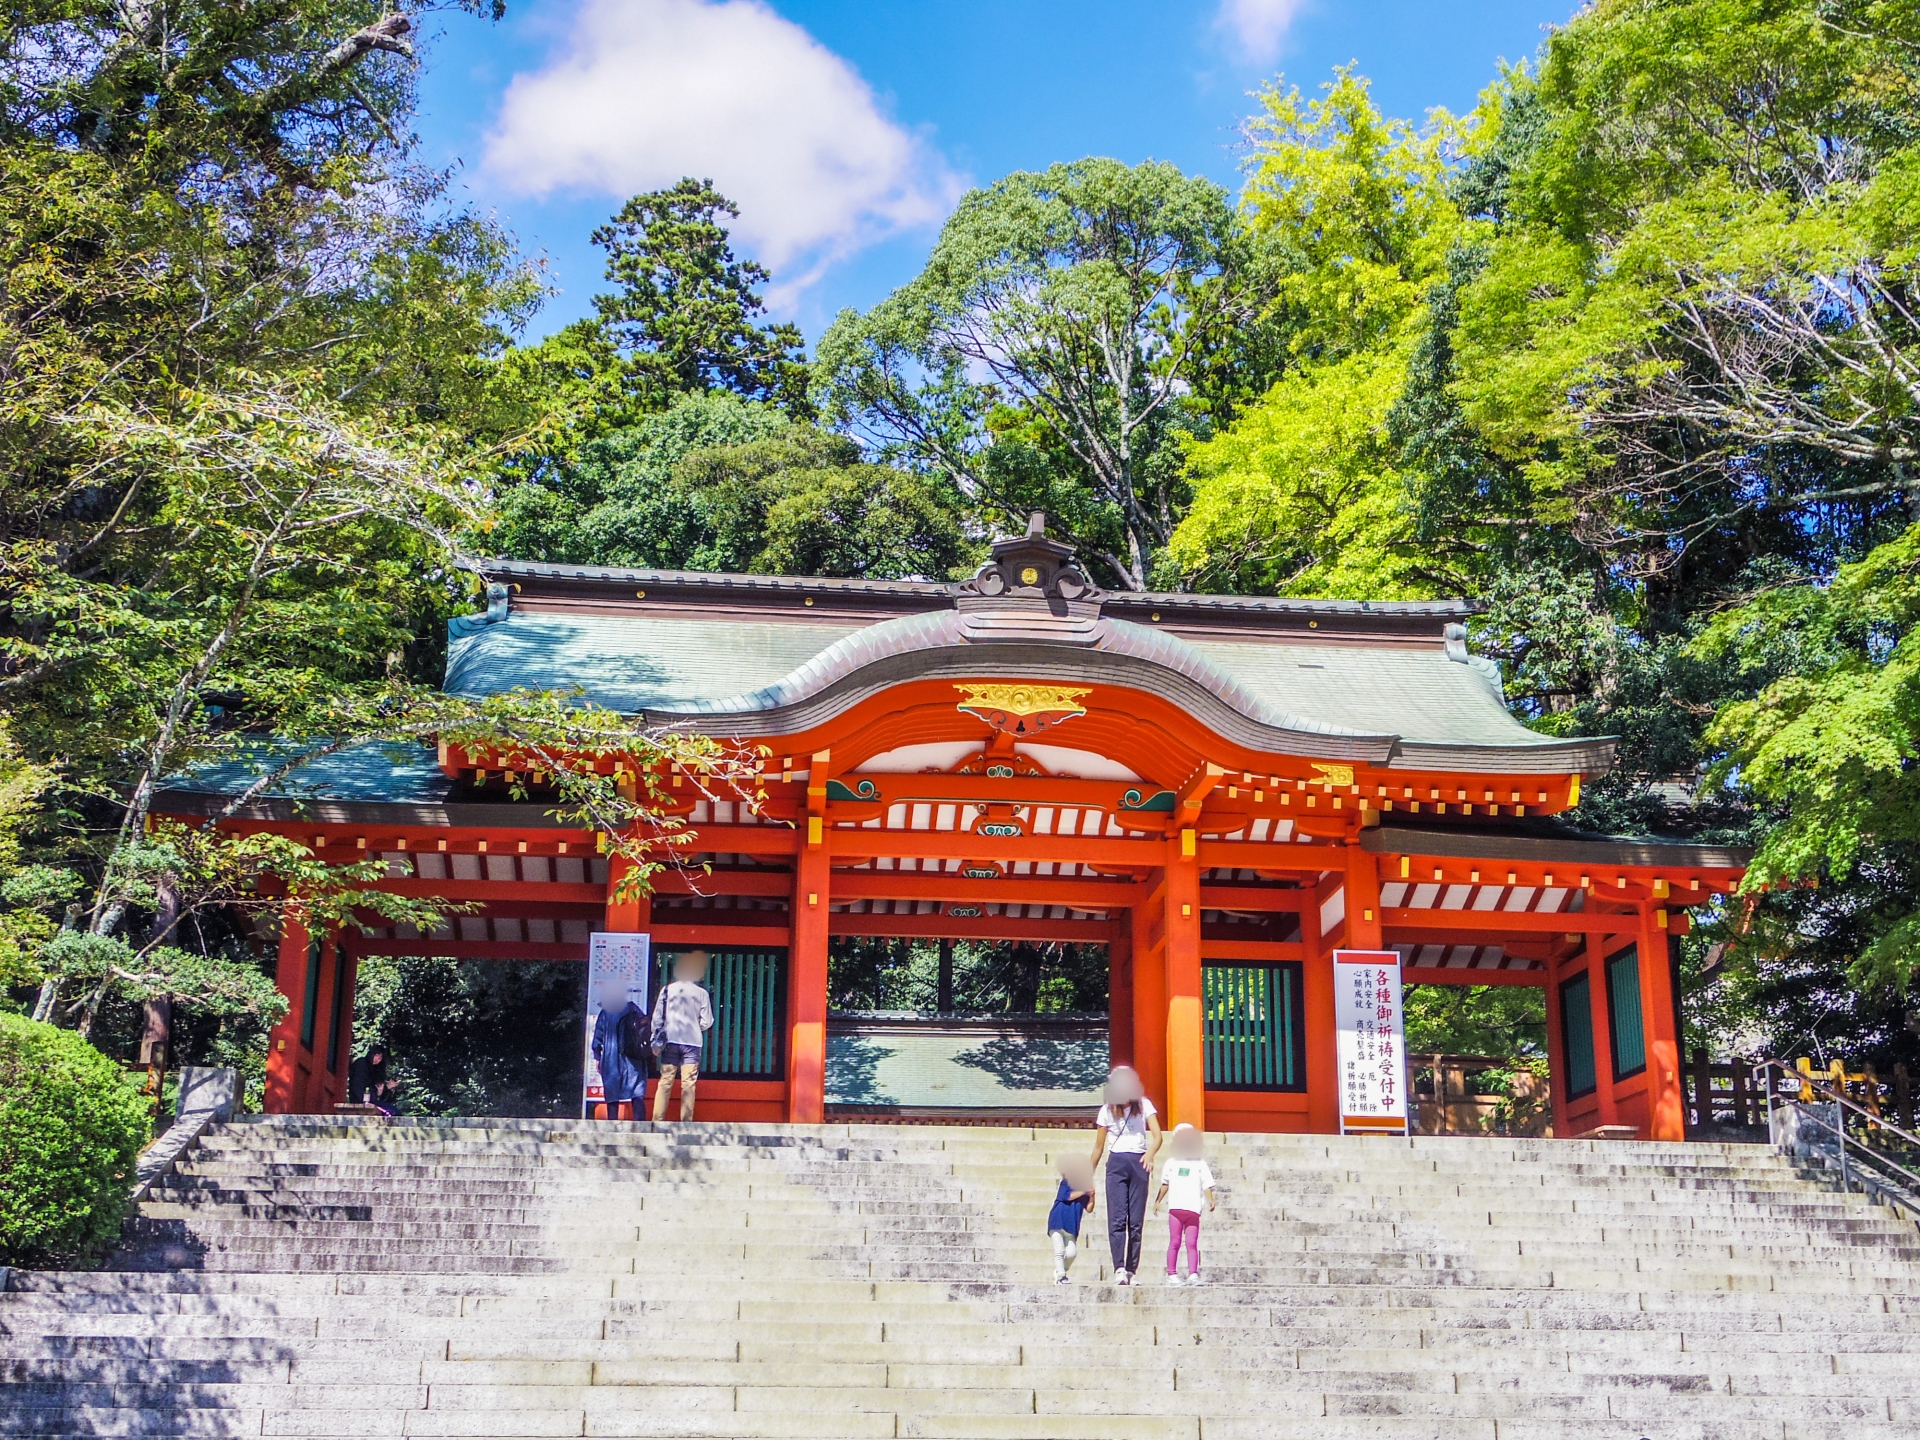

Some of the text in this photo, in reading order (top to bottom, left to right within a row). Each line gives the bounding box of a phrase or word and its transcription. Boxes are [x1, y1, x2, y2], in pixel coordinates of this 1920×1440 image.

[1353, 970, 1364, 1009] 心願成就
[1363, 968, 1373, 1009] 家内安全
[1366, 1019, 1375, 1061] 交通安全
[1375, 969, 1395, 1112] 各種御祈祷受付中
[1347, 1061, 1357, 1112] 諸祈願受付
[1357, 1072, 1368, 1112] 必勝祈願
